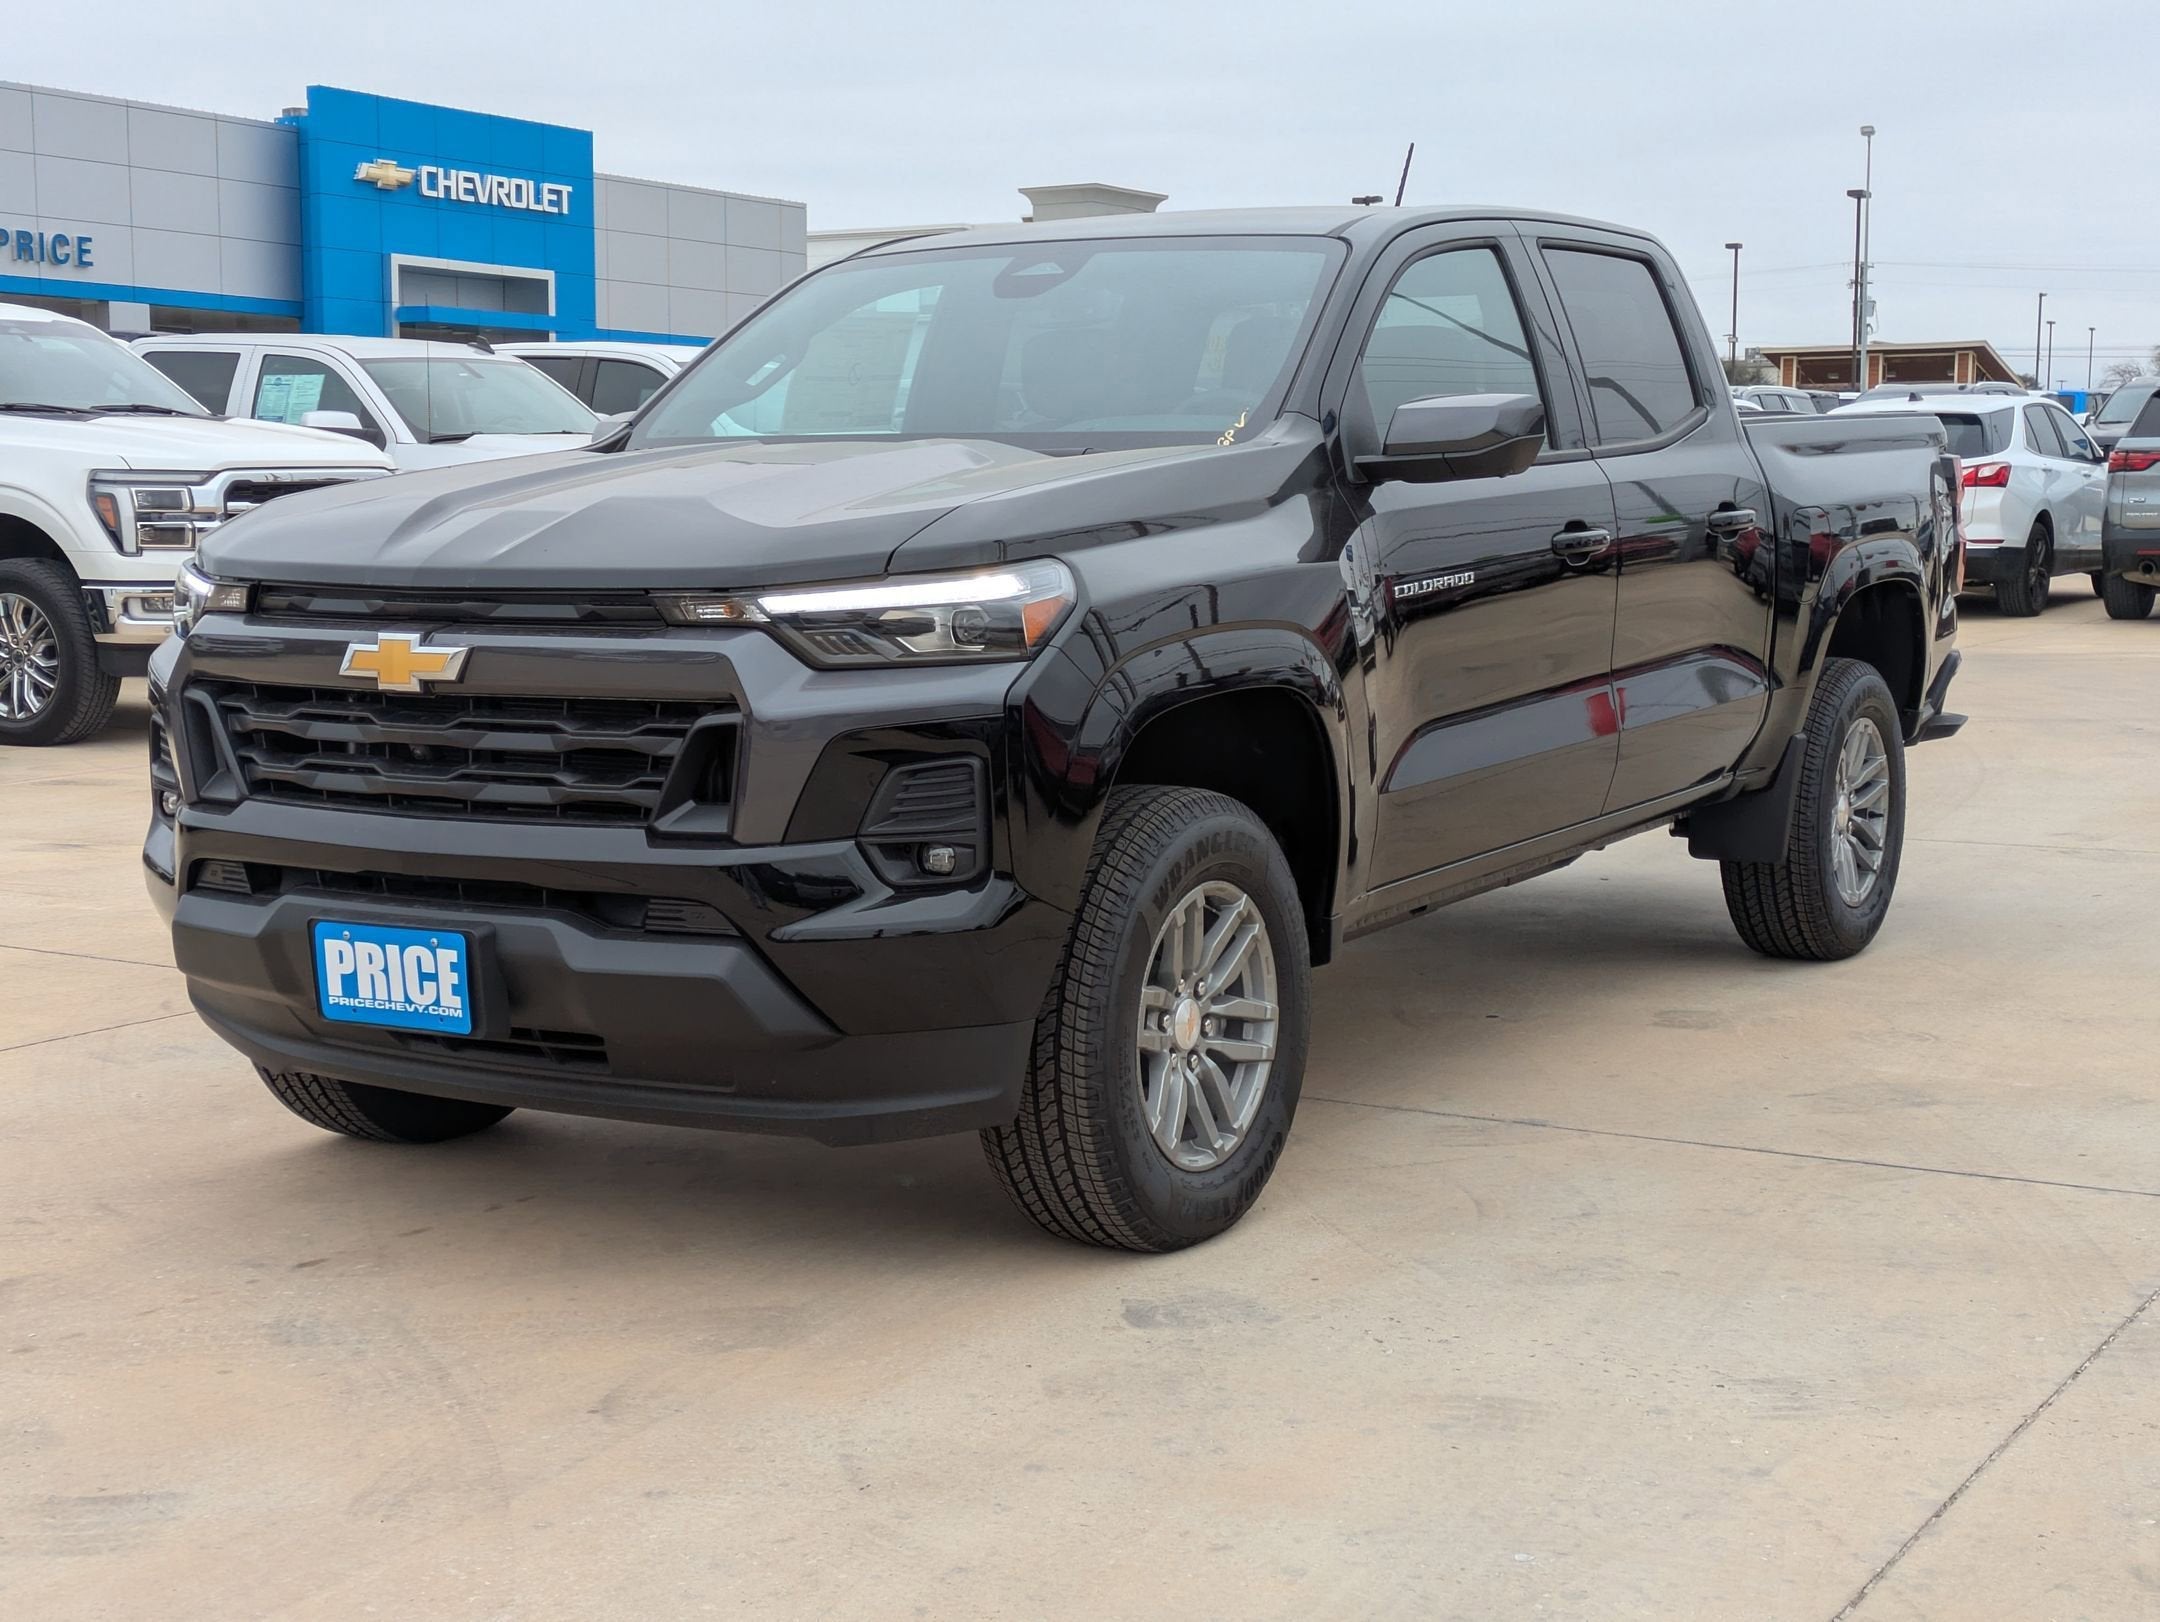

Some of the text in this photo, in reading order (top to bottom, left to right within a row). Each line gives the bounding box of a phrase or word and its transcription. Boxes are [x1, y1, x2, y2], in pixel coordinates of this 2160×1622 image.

[418, 165, 573, 214] CHEVROLET
[1394, 571, 1475, 599] COLORADO
[323, 938, 462, 1009] PRICE
[328, 996, 463, 1018] PRICECHEVY.COM
